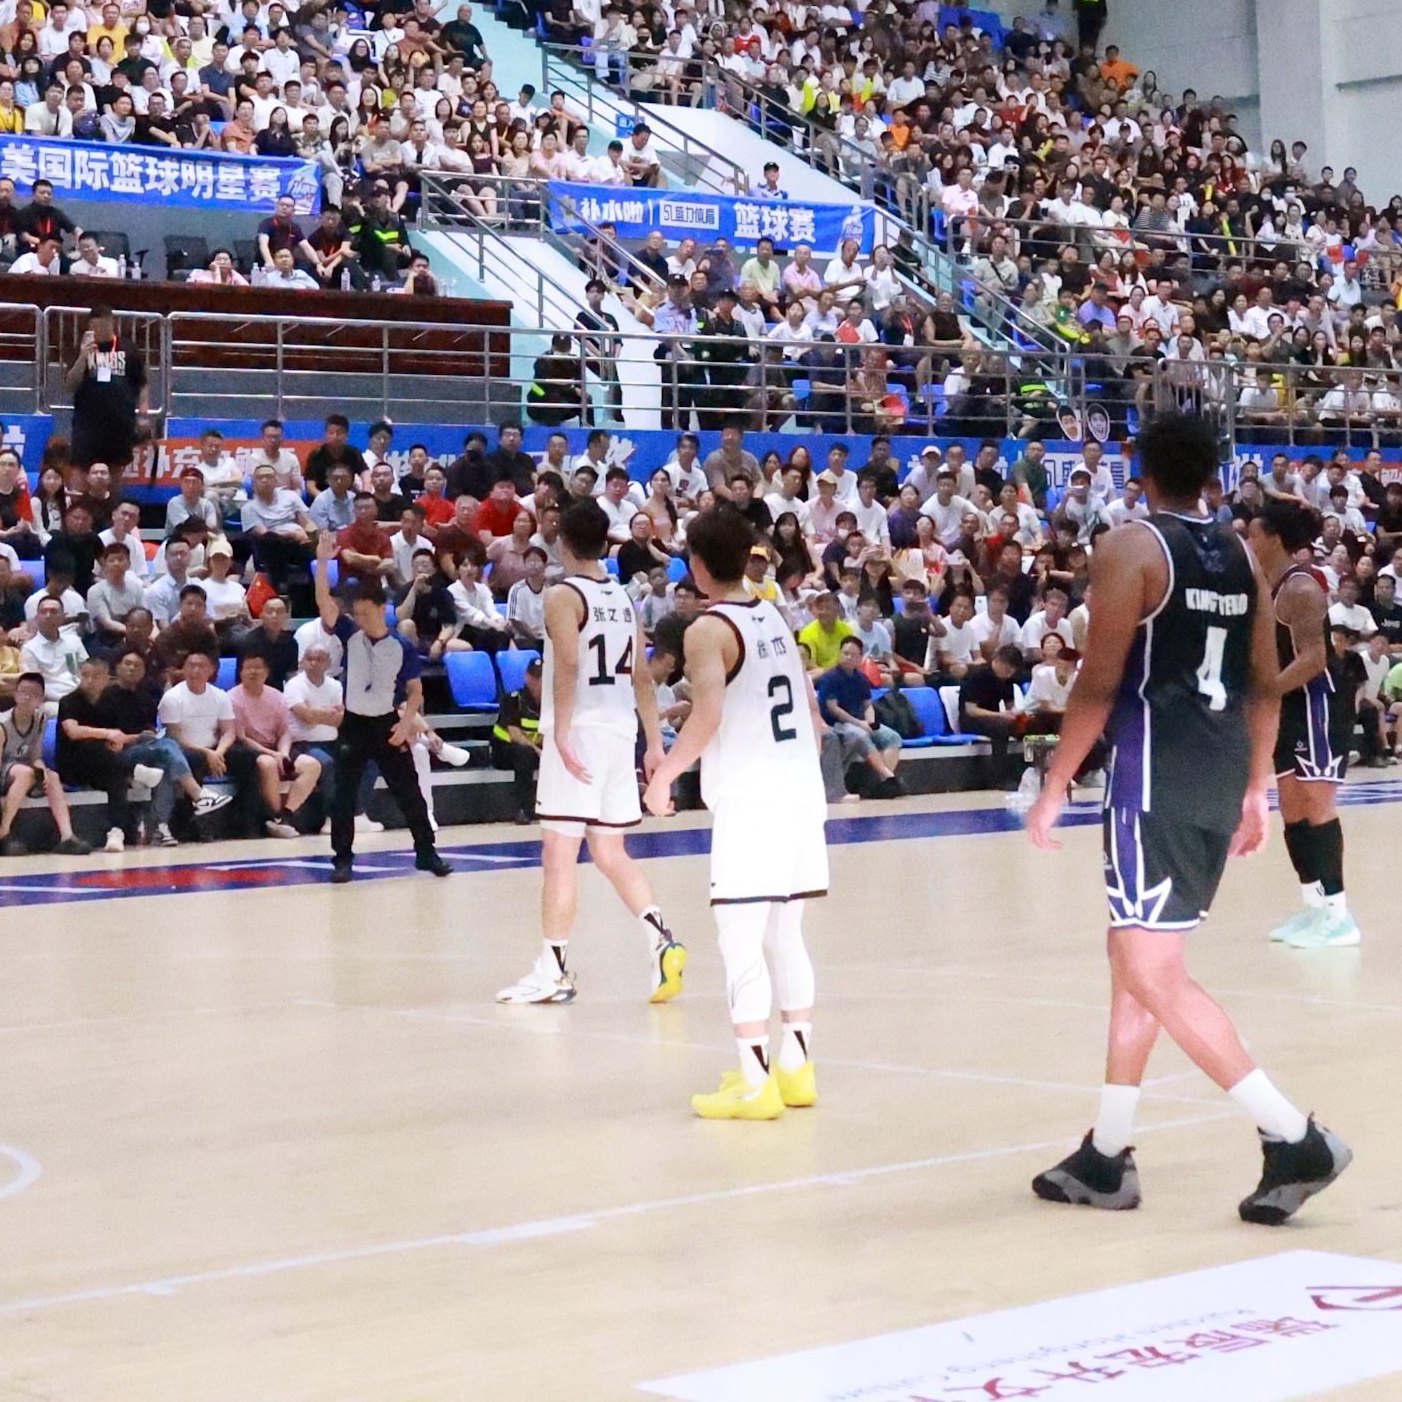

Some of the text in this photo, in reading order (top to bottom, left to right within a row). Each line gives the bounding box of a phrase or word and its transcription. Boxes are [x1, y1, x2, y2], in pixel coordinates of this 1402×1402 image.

[580, 196, 645, 225] 补水啦
[733, 201, 817, 244] 篮球赛
[588, 634, 634, 686] 14
[767, 674, 798, 743] 2
